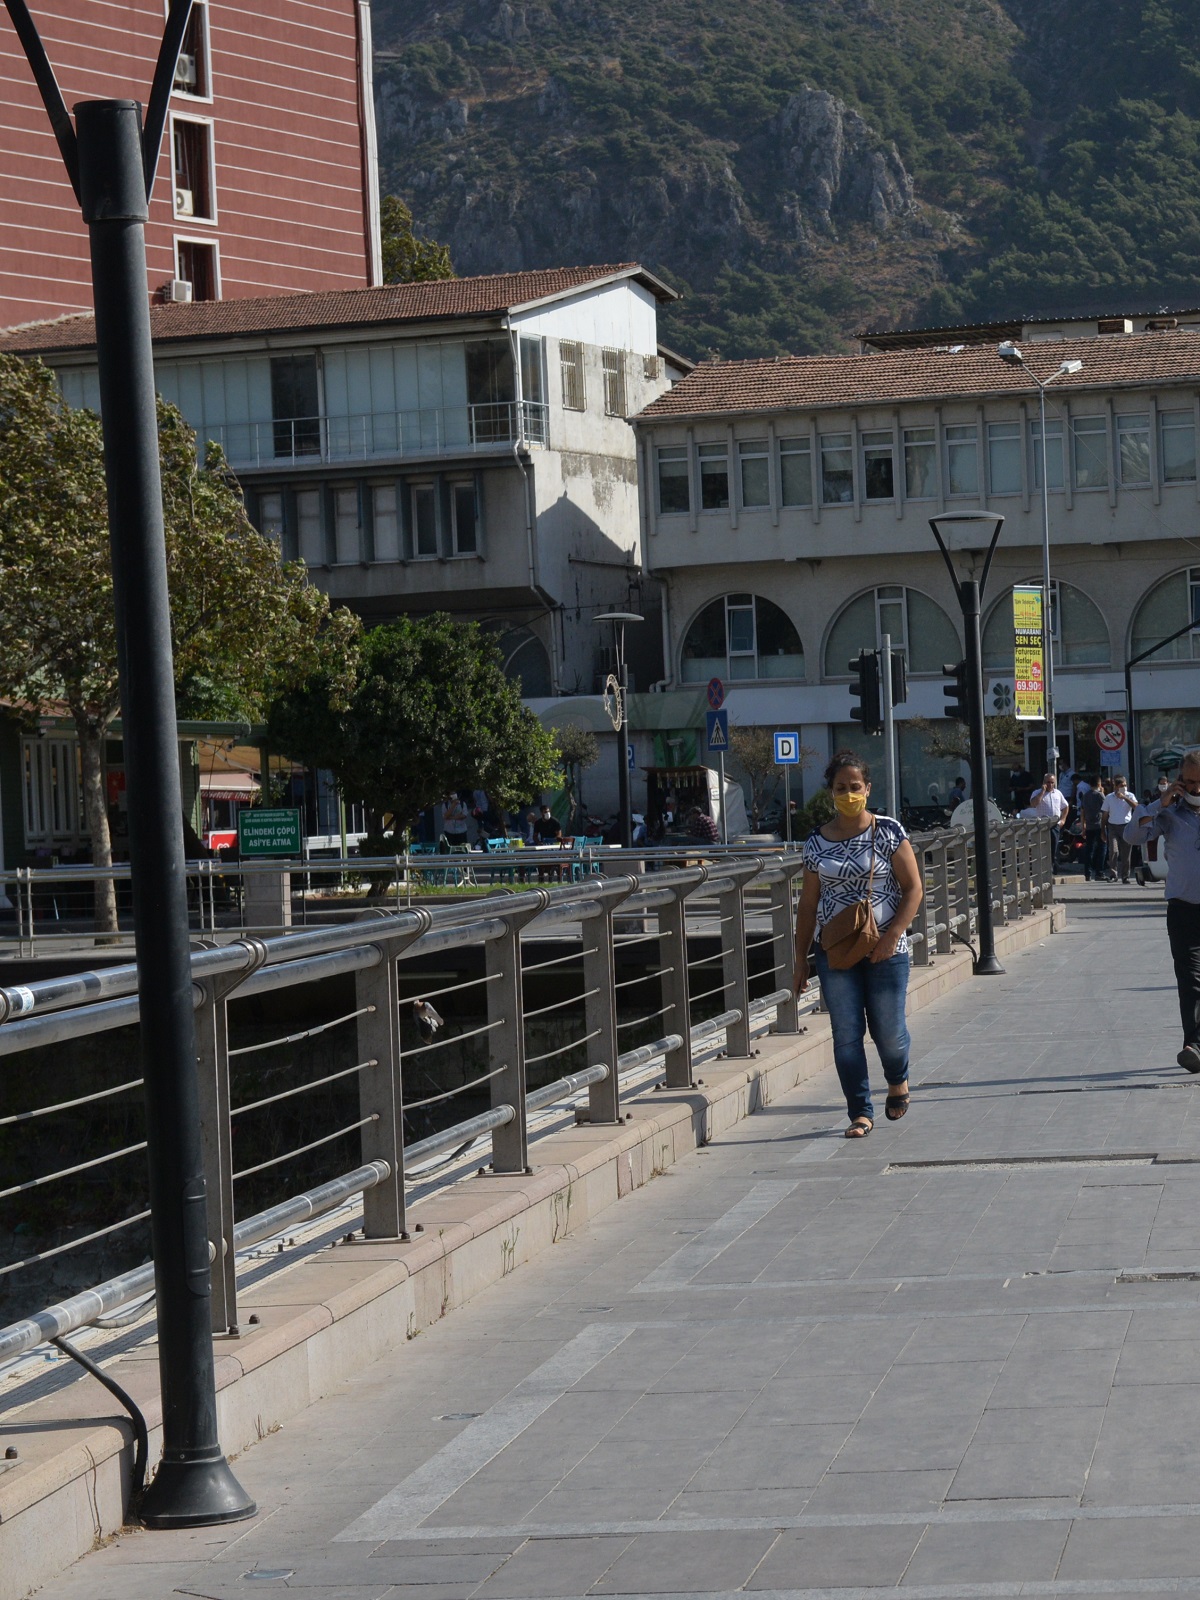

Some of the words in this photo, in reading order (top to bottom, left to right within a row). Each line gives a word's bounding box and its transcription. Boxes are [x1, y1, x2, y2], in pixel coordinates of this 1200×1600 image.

[1015, 636, 1028, 645] SEN
[1030, 636, 1042, 647] SEÇ
[1015, 648, 1040, 656] Faturasız
[781, 740, 792, 756] D
[243, 826, 275, 836] ELİNDEKİ
[276, 826, 296, 837] ÇÖPÜ
[248, 837, 271, 847] ASİ'YE
[272, 838, 292, 846] ATMA
